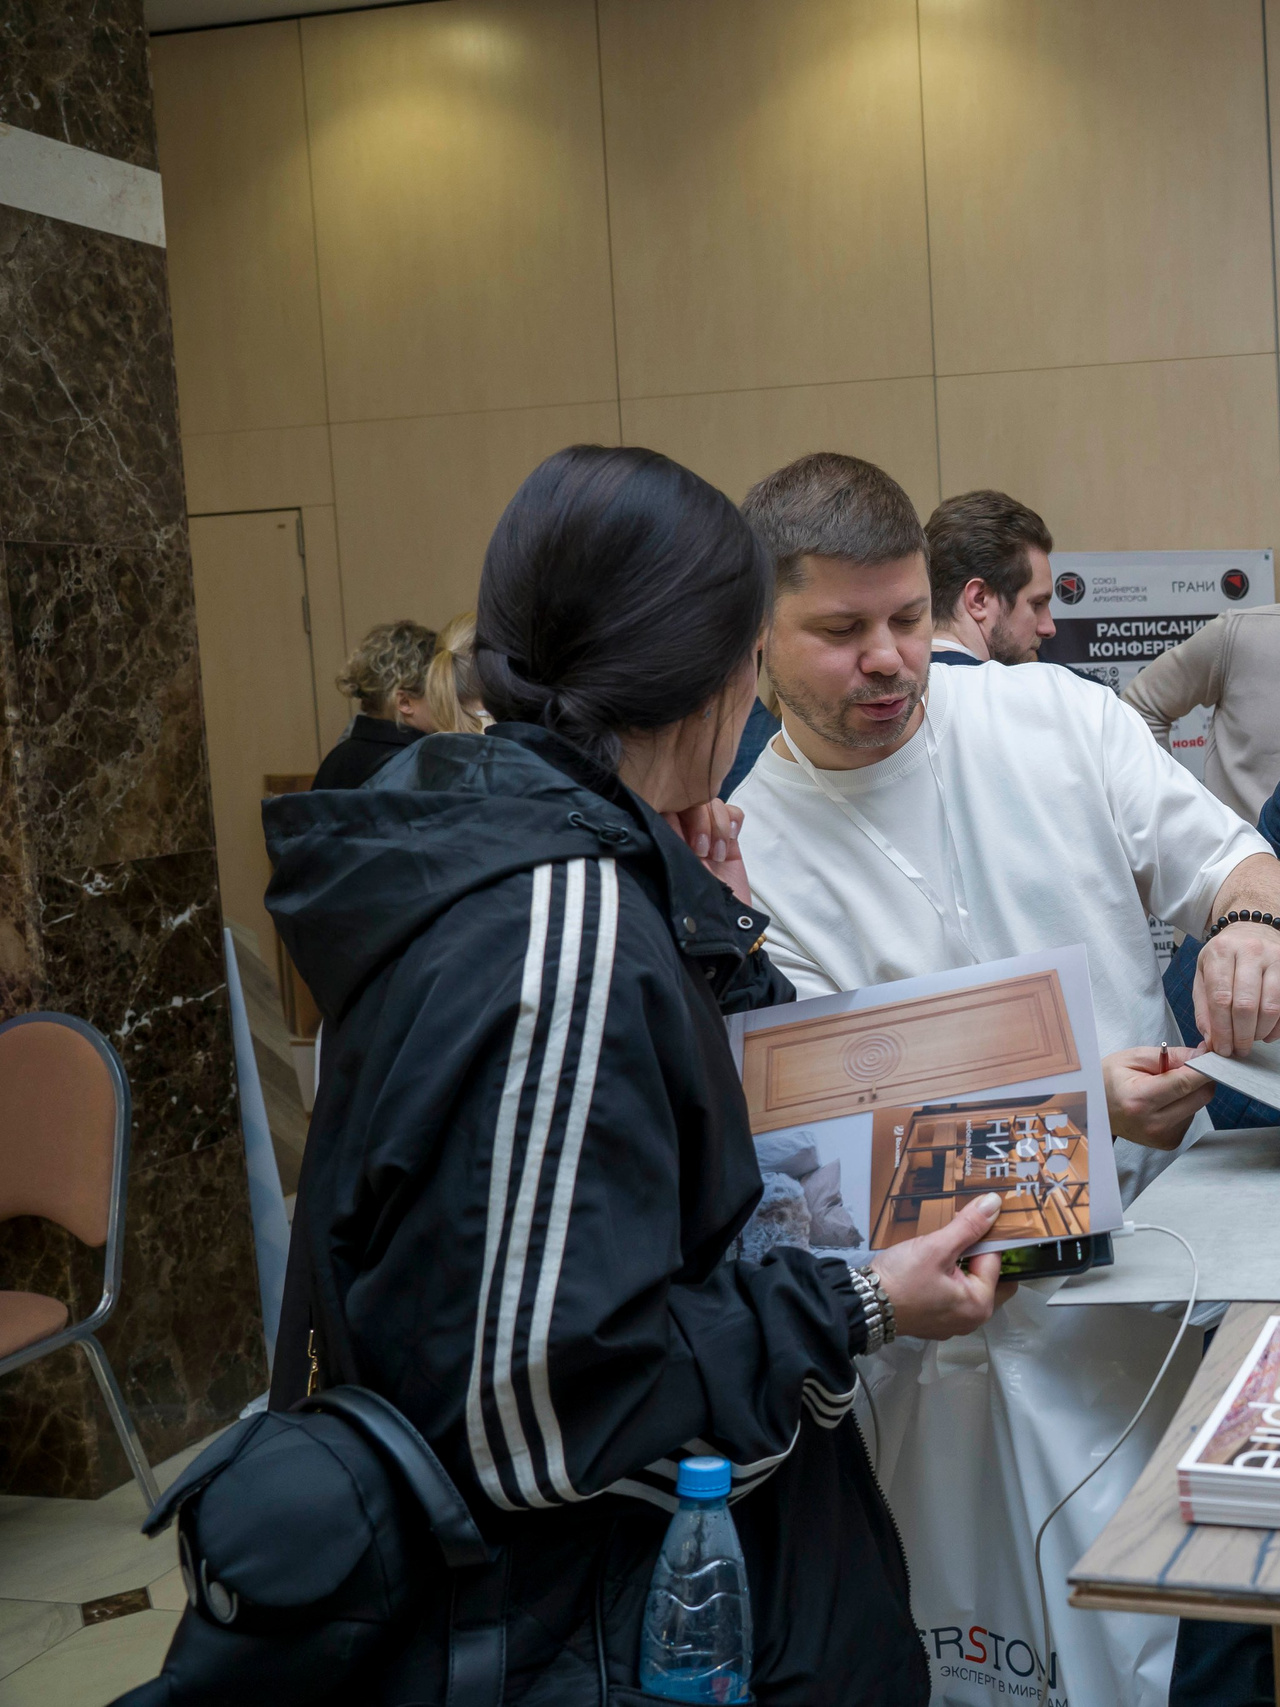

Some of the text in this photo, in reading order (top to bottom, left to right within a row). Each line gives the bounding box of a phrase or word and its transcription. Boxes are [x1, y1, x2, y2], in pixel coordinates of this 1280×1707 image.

[1092, 577, 1117, 586] СОЮЗ
[1172, 581, 1216, 594] ГРАНИ
[1172, 735, 1208, 749] нояб
[986, 1119, 1010, 1180] НИЕ
[1016, 1116, 1040, 1197] НОВЕ
[1043, 1113, 1070, 1196] ВДОХ
[918, 1625, 1058, 1690] RSTON
[940, 1665, 997, 1690] ЭКСПЕРТ
[998, 1679, 1006, 1692] В
